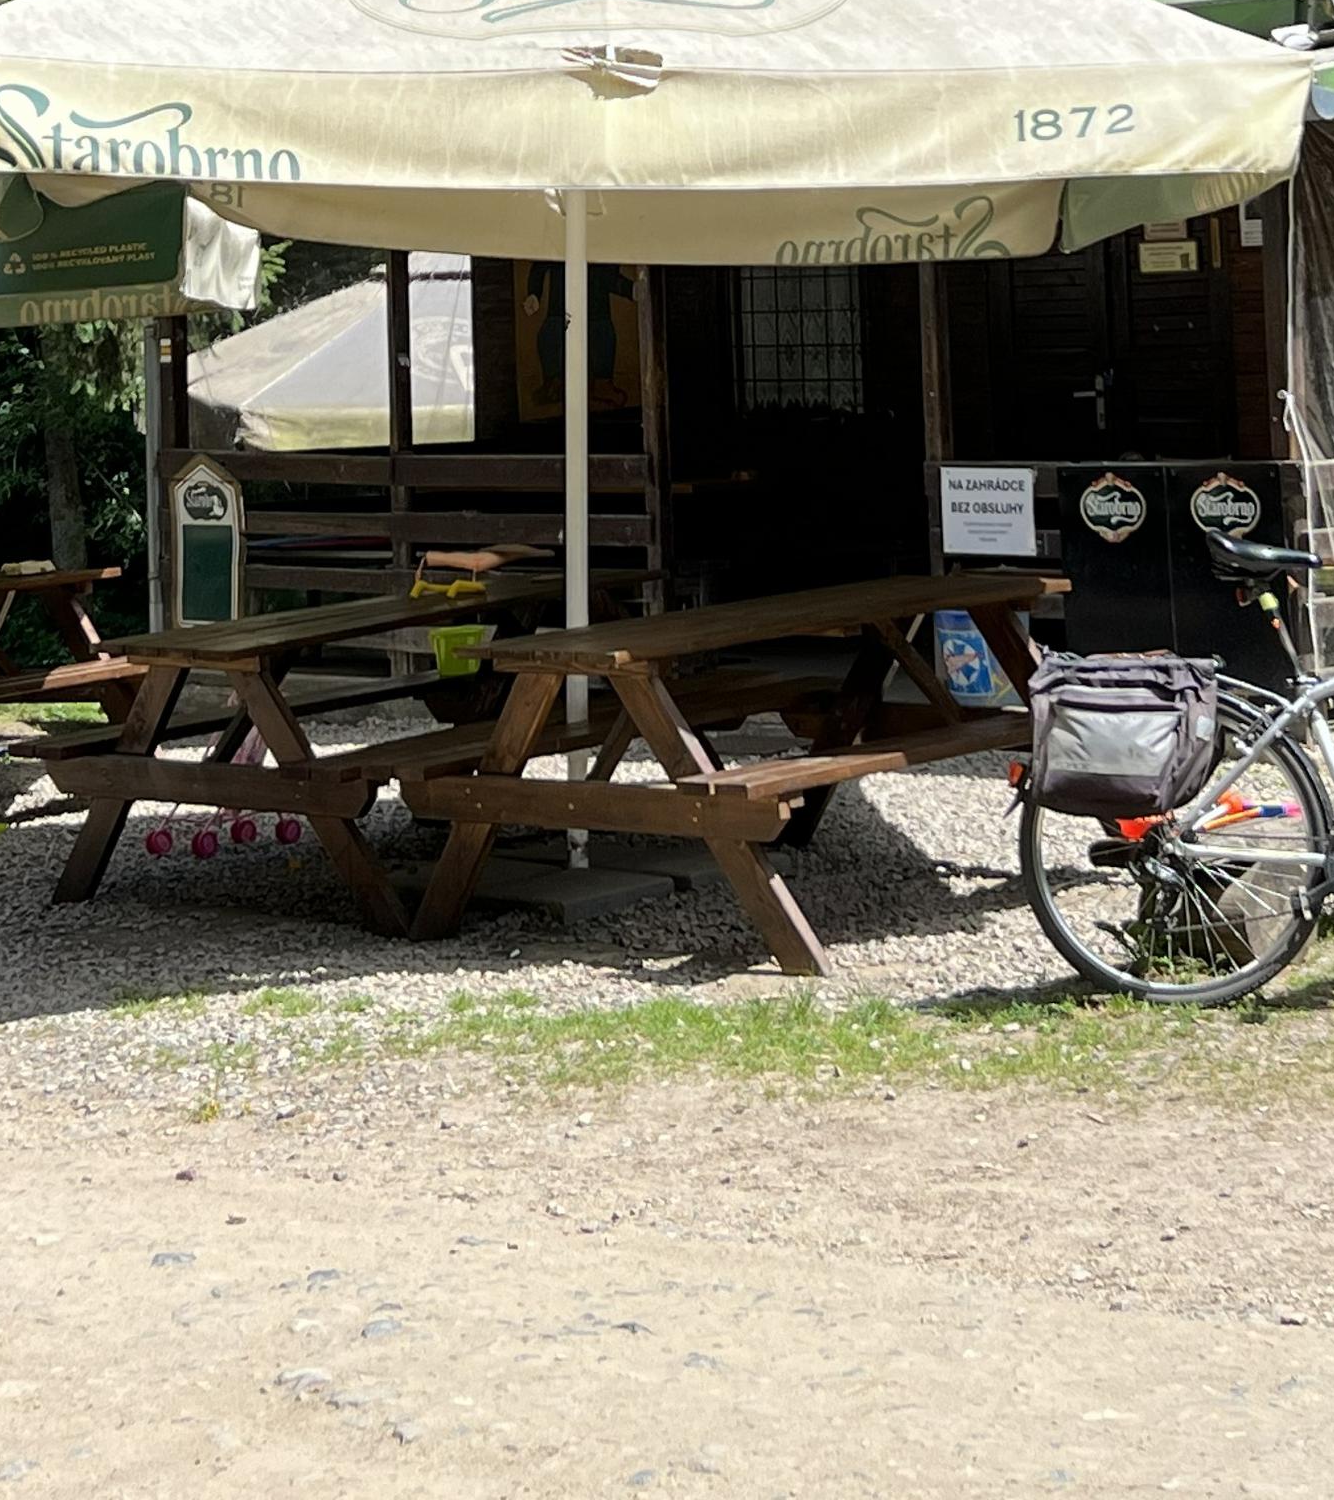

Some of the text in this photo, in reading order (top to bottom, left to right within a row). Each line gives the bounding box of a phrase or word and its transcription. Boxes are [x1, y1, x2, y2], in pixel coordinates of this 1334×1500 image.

[1014, 104, 1136, 141] 1872
[948, 477, 1025, 491] NA ZAHRÁDCE
[951, 501, 1024, 514] BEZ OBSLUHY
